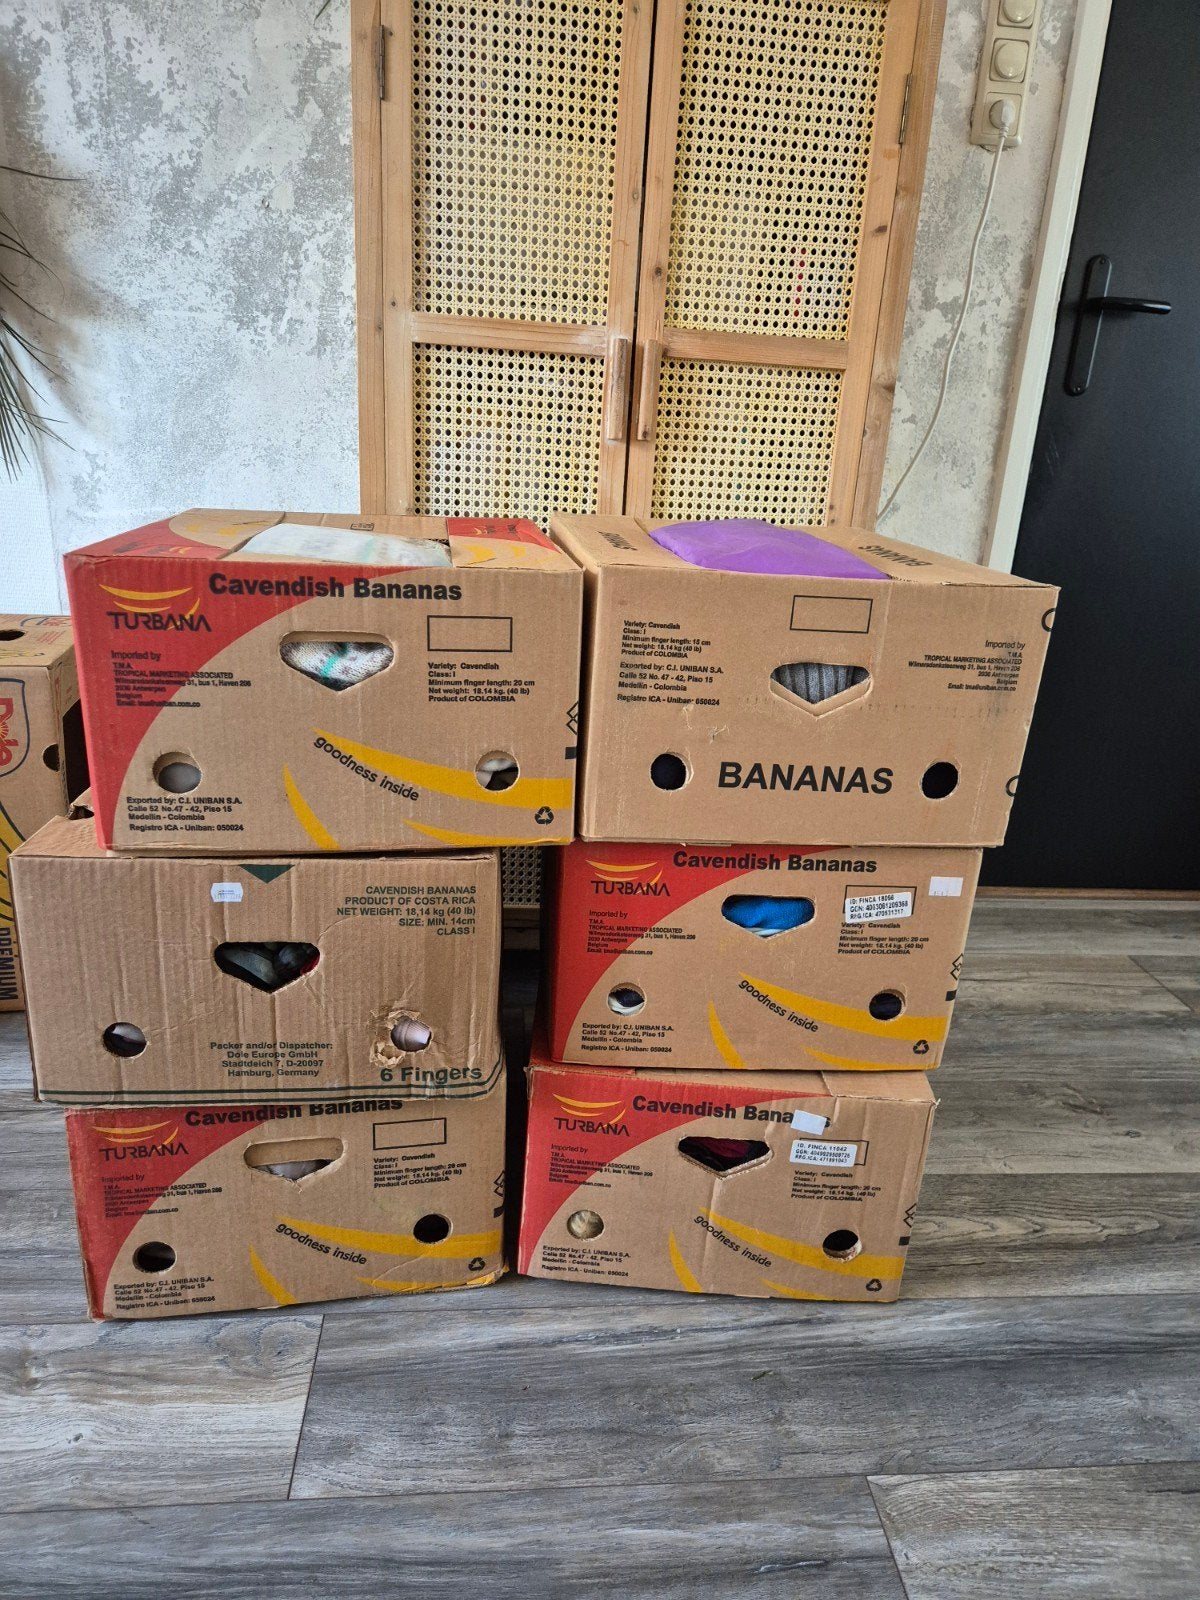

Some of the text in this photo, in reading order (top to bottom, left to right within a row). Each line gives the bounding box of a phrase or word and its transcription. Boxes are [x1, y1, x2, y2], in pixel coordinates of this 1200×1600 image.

[209, 573, 461, 600] Cavendish Bananas
[107, 611, 212, 631] TURBANA
[624, 620, 680, 630] Variety: Cavendish
[428, 662, 456, 670] Variety:
[620, 662, 652, 670] Exported
[653, 663, 664, 671] by:
[654, 683, 687, 691] Colombia
[617, 694, 647, 702] Registro
[667, 696, 693, 704] Uniban:
[314, 737, 419, 801] goodness inside
[718, 762, 893, 794] BANANAS
[164, 797, 176, 805] by:
[130, 824, 162, 832] Registro
[673, 851, 878, 873] Cavendish Bananas
[366, 886, 476, 895] CAVENDISH BANANAS
[590, 881, 670, 897] TURBANA
[345, 896, 476, 905] PRODUCT OF COSTA RICA
[337, 907, 476, 917] NET WEIGHT: 18,14 kg (40 lb)
[590, 910, 619, 918] Imported
[398, 917, 476, 926] SIZE: MIN. 14cm
[436, 927, 470, 936] CLASS
[738, 980, 818, 1032] goodness inside
[280, 1042, 333, 1051] Dispatcher:
[252, 1051, 286, 1059] Europe
[222, 1060, 272, 1068] Stadtdeich
[227, 1069, 319, 1078] Hamburg, Germany
[380, 1066, 483, 1084] 6 Fingers
[185, 1100, 403, 1126] Cavendish Bananas
[633, 1095, 831, 1128] Cavendish Banas
[554, 1117, 630, 1137] TURBANA
[100, 1142, 189, 1160] TURBANA
[275, 1223, 367, 1265] goodness inside
[693, 1215, 772, 1267] goodness inside
